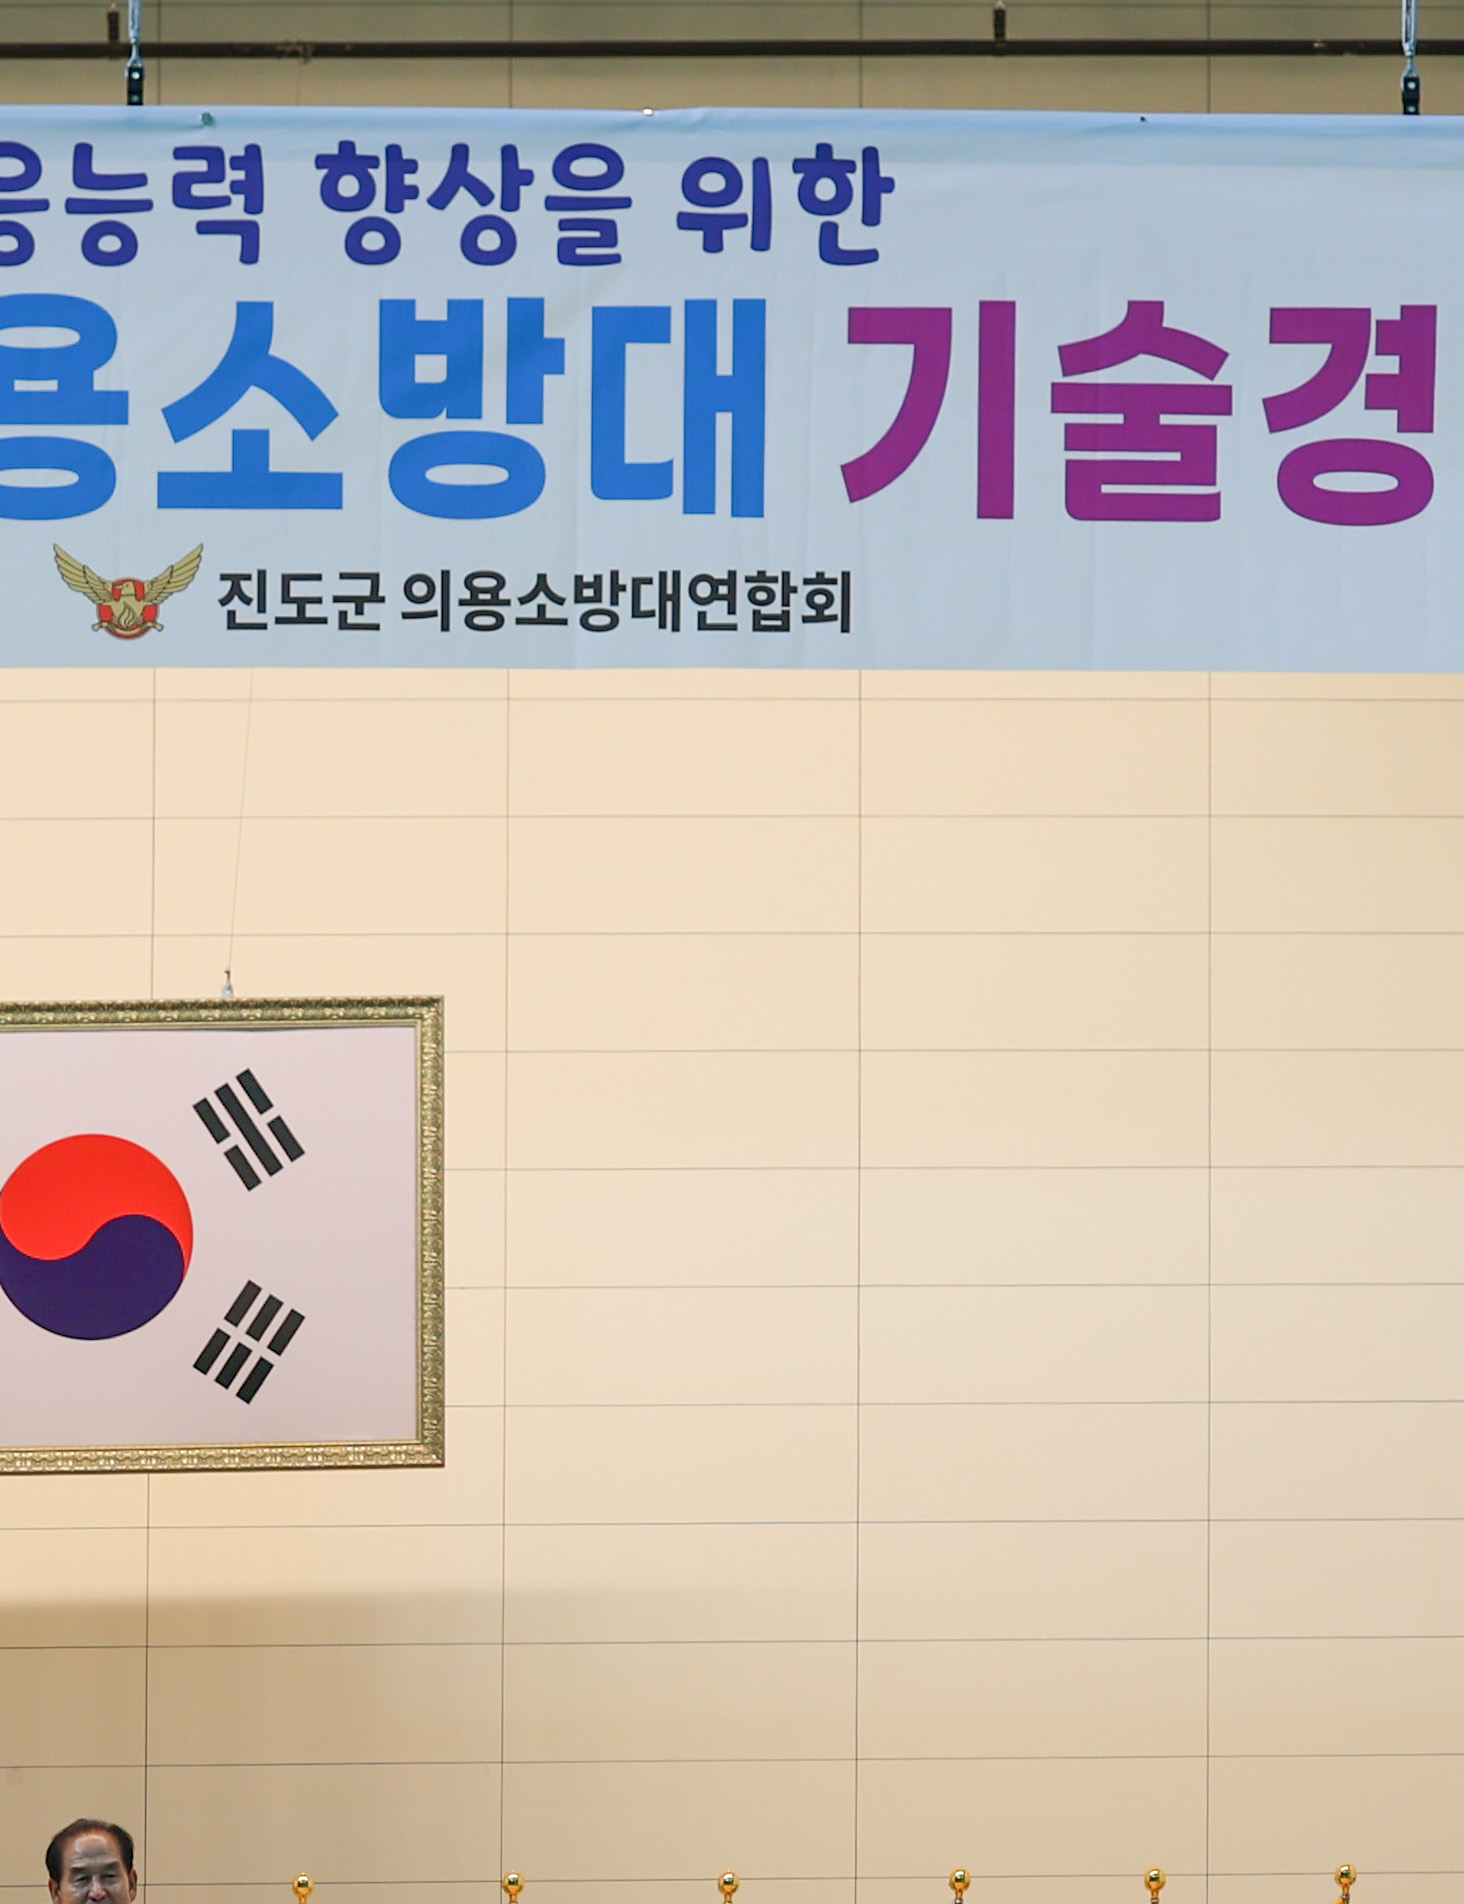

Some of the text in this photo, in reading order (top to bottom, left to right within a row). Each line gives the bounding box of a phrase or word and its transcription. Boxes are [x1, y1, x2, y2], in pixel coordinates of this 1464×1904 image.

[315, 141, 632, 267] 향상을
[677, 144, 895, 267] 위한
[218, 569, 852, 636] 진도군 의용소방대연합회
